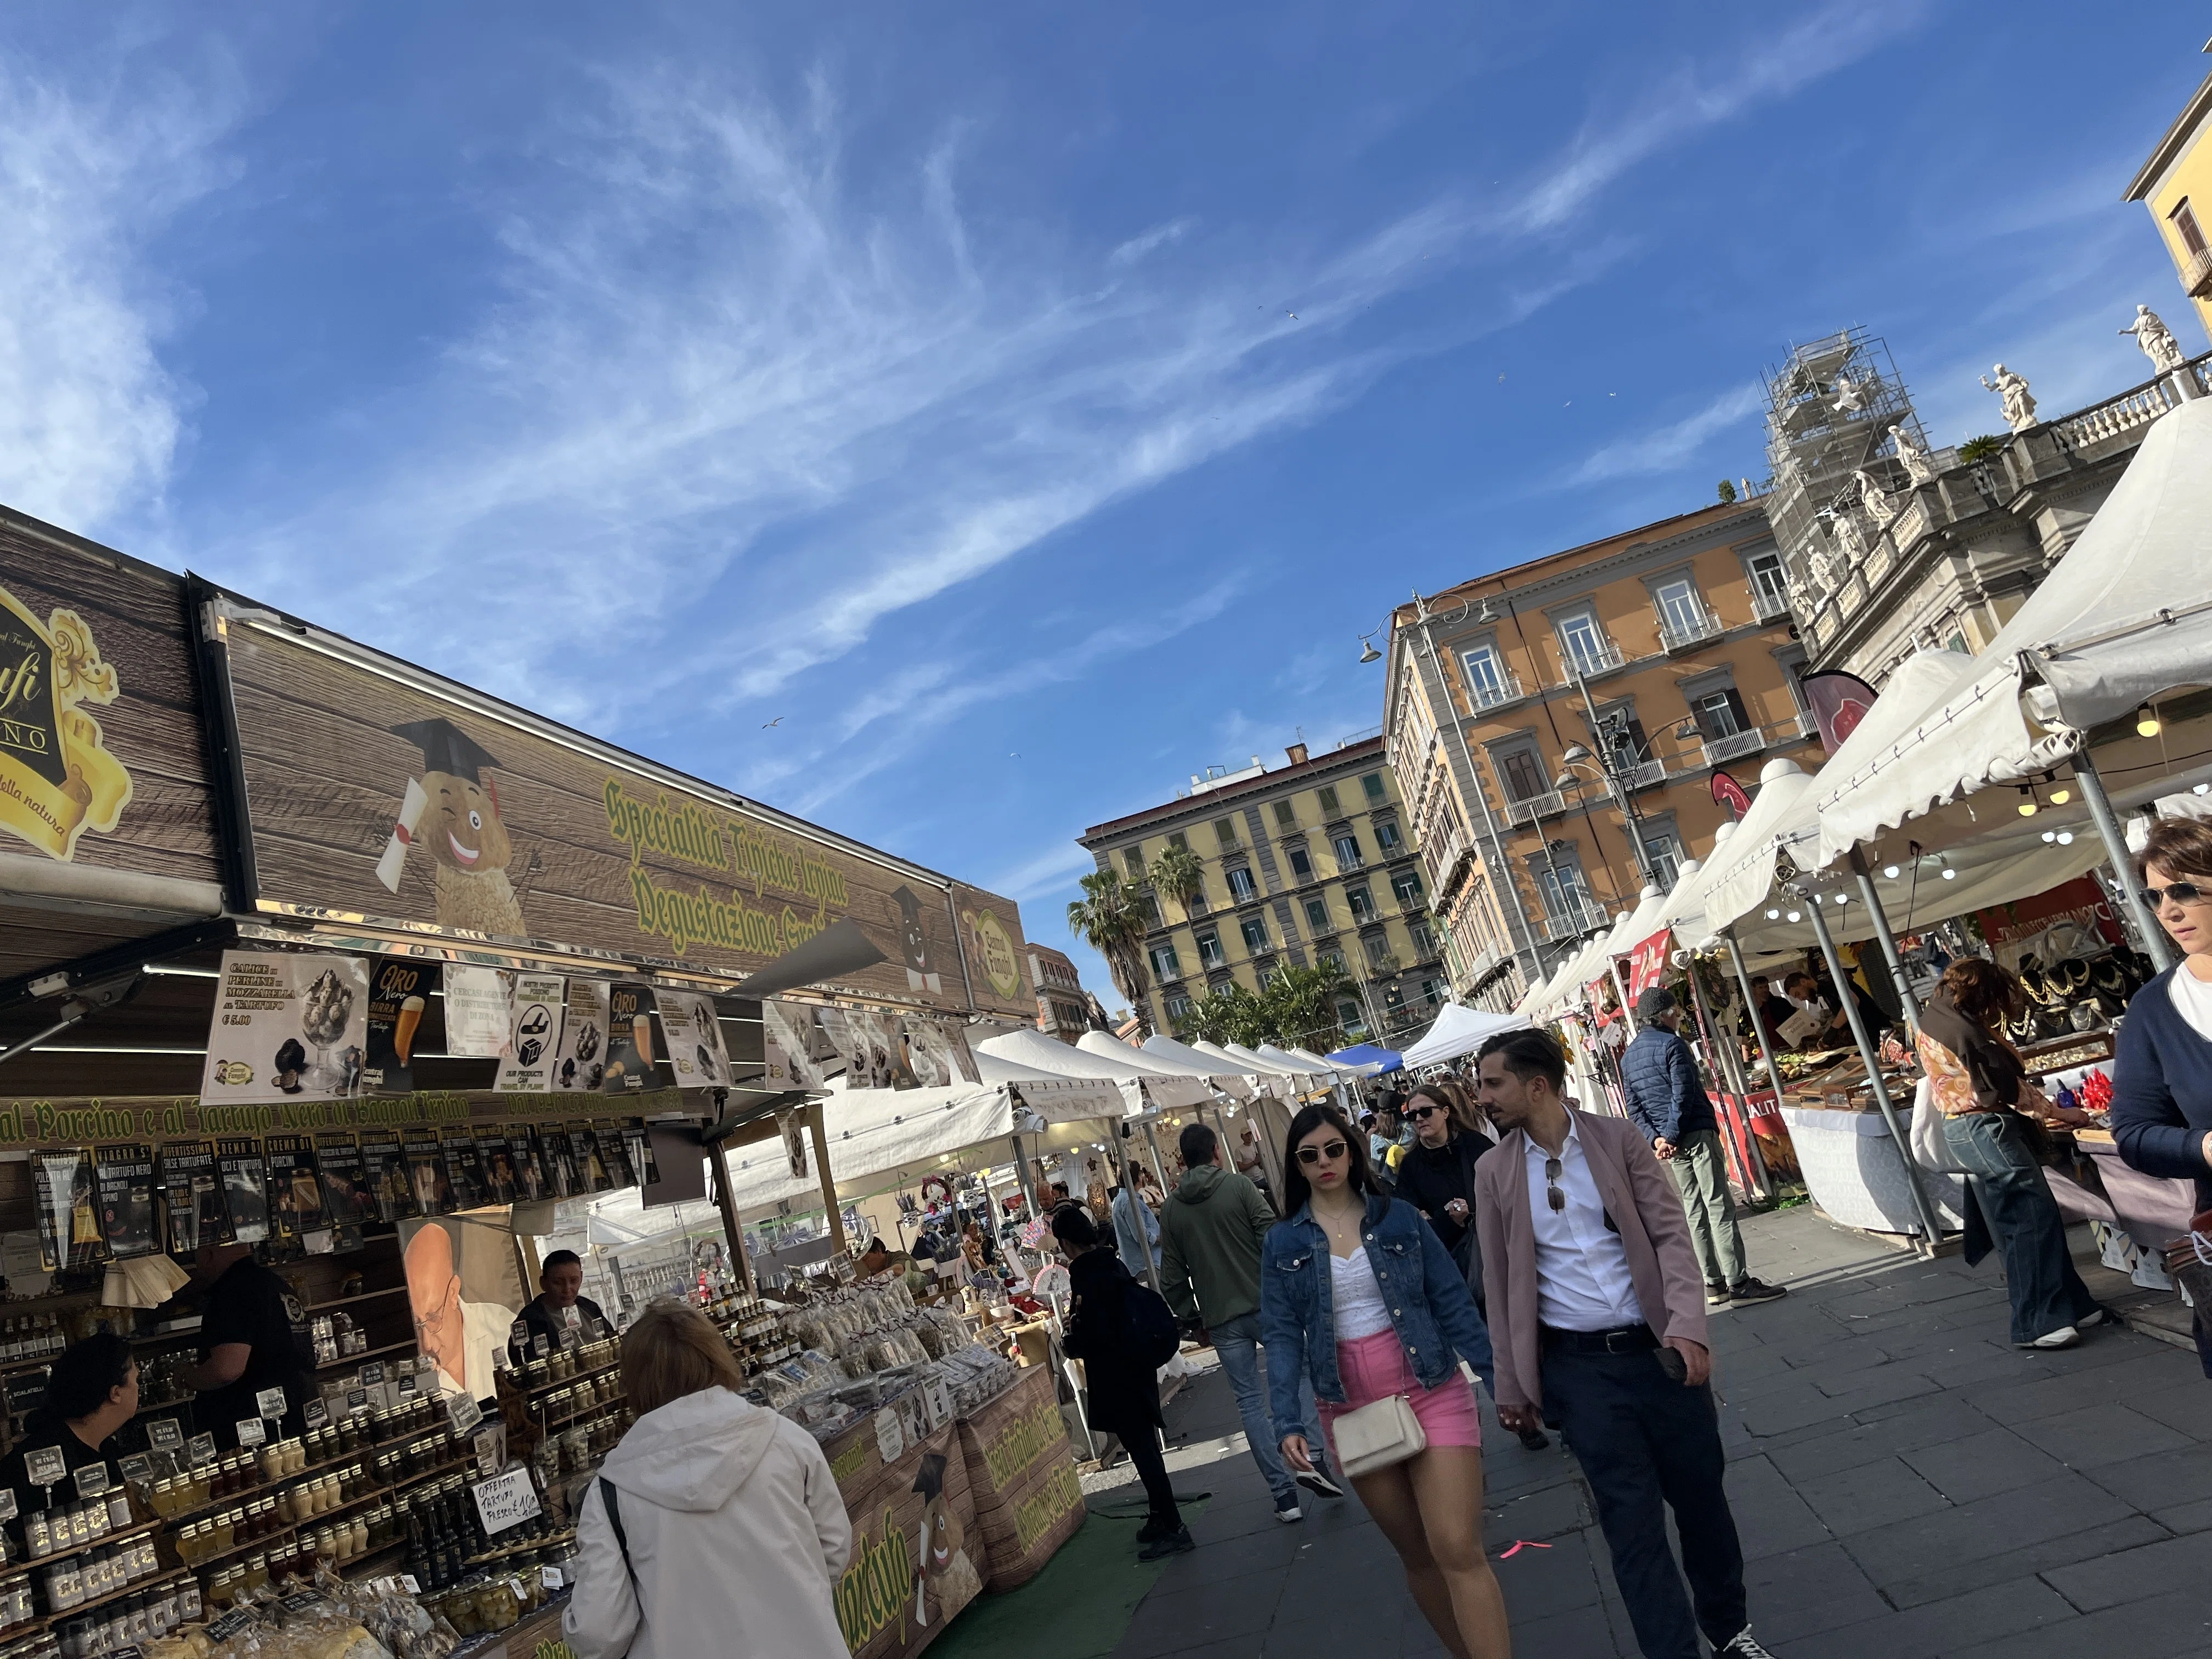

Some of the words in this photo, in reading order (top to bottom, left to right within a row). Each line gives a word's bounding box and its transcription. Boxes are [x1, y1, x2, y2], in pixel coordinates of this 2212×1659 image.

[23, 795, 66, 838] natura
[605, 775, 729, 871] Specialità
[727, 818, 799, 899] Tipiche
[629, 866, 781, 957] Degustazione
[985, 930, 1007, 952] Central
[230, 963, 269, 974] CALICE
[987, 950, 1013, 980] Funghi
[228, 975, 275, 986] PERLINE
[379, 964, 419, 992] ORO
[225, 987, 295, 999] MOZZARELLA
[375, 986, 408, 1001] Nero
[453, 987, 482, 997] CERCASI
[234, 1000, 285, 1011] TARTUFO
[369, 1001, 396, 1014] BIRRA
[454, 999, 460, 1007] O
[612, 991, 637, 1013] ORO
[230, 1014, 251, 1026] 5.00
[613, 1009, 636, 1022] Nero
[33, 1097, 134, 1142] Porcino
[143, 1108, 156, 1134] e
[163, 1098, 190, 1135] al
[195, 1099, 273, 1136] Tartufo
[281, 1102, 328, 1130] Nero
[357, 1091, 421, 1129] Bagnoli
[162, 1143, 211, 1158] OFFERTISSIMA
[251, 1141, 261, 1153] DI
[268, 1139, 296, 1152] CREMA
[299, 1138, 309, 1150] DI
[33, 1152, 88, 1167] OFFERTISSIMA
[97, 1148, 134, 1163] VIAGRA
[163, 1158, 178, 1169] SALSE
[178, 1154, 213, 1169] TARTUFATE
[270, 1155, 296, 1168] PORCINI
[99, 1168, 107, 1180] AL
[108, 1165, 135, 1180] TARTUFO
[135, 1164, 151, 1176] NERO
[233, 1160, 237, 1171] E
[236, 1159, 262, 1171] TARTUFO
[99, 1182, 106, 1192] DI
[106, 1180, 128, 1192] BAGNOLI
